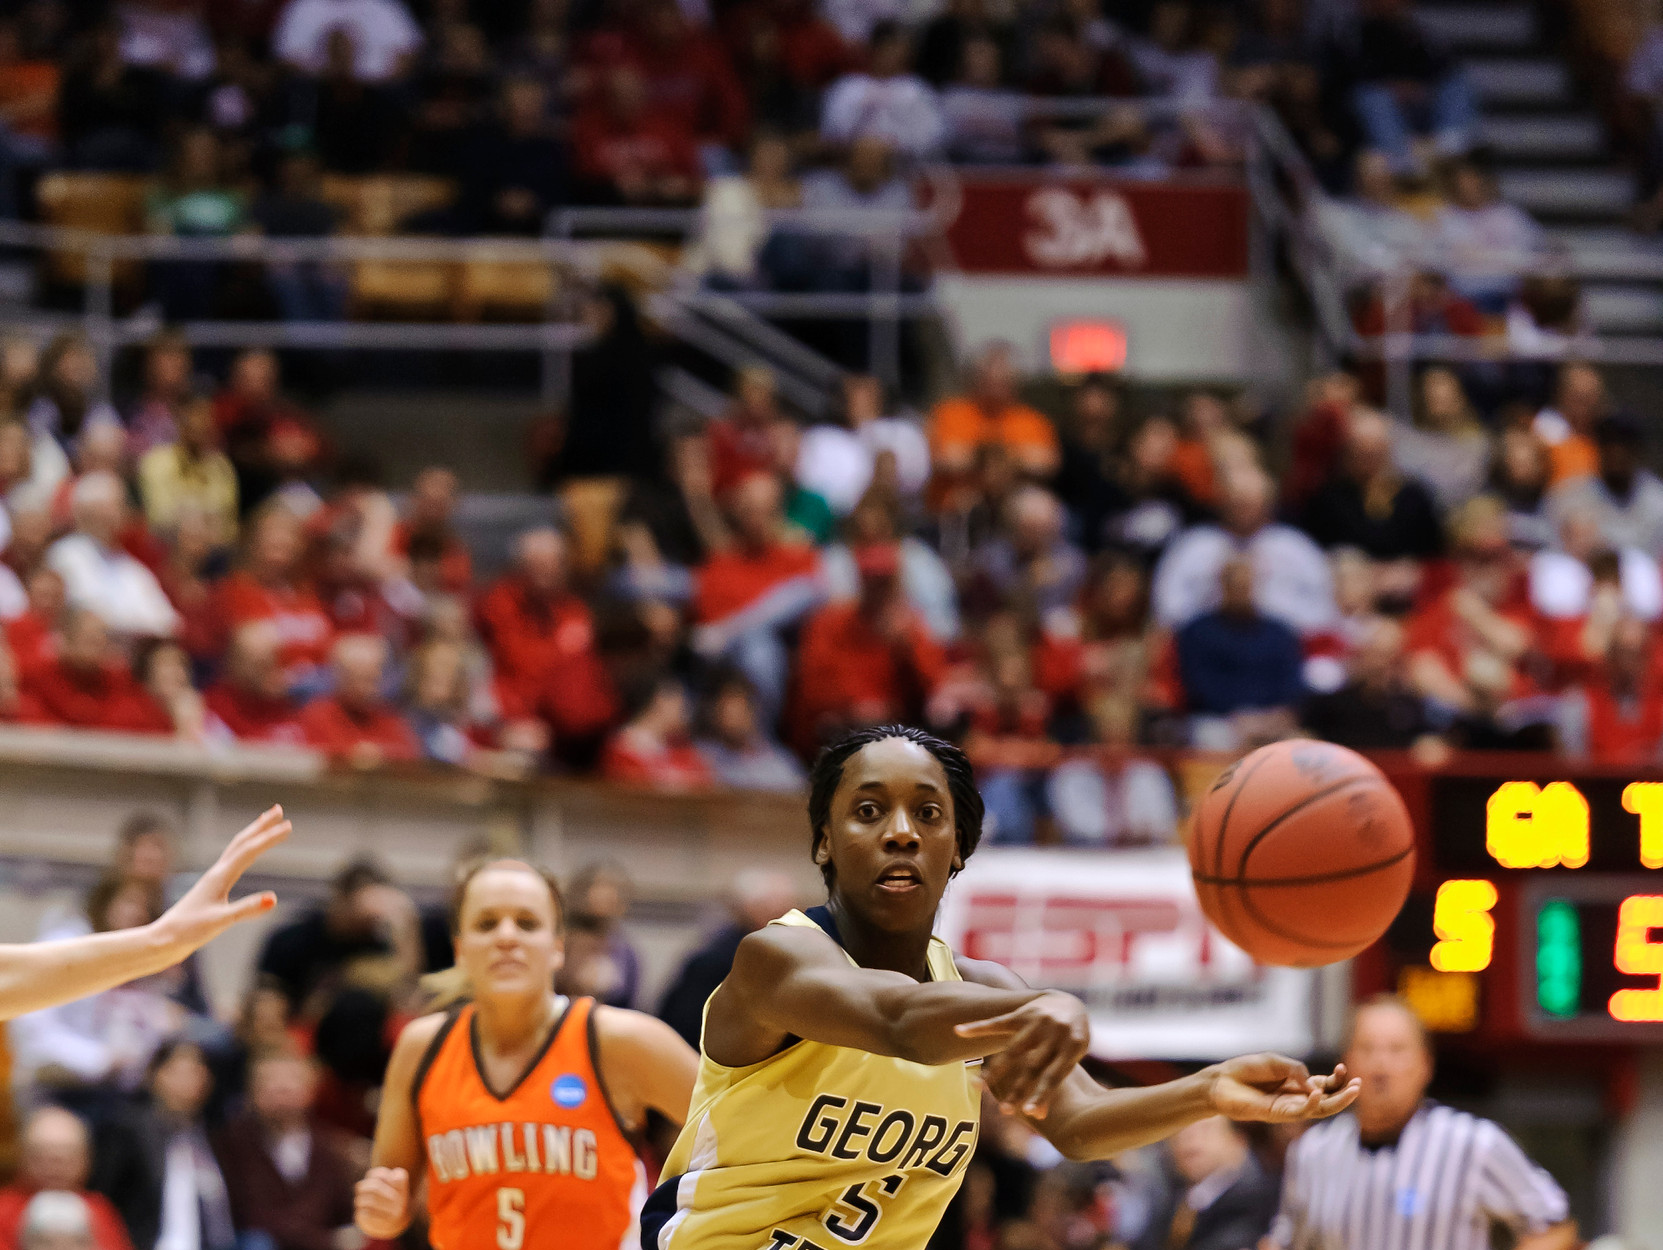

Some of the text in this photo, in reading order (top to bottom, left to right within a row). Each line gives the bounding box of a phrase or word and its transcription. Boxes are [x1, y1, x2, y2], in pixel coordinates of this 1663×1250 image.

[1023, 187, 1146, 268] 3A
[963, 894, 1262, 972] ESP
[427, 1121, 598, 1183] BOWLING
[796, 1093, 979, 1178] GEORG
[822, 1173, 909, 1246] 5
